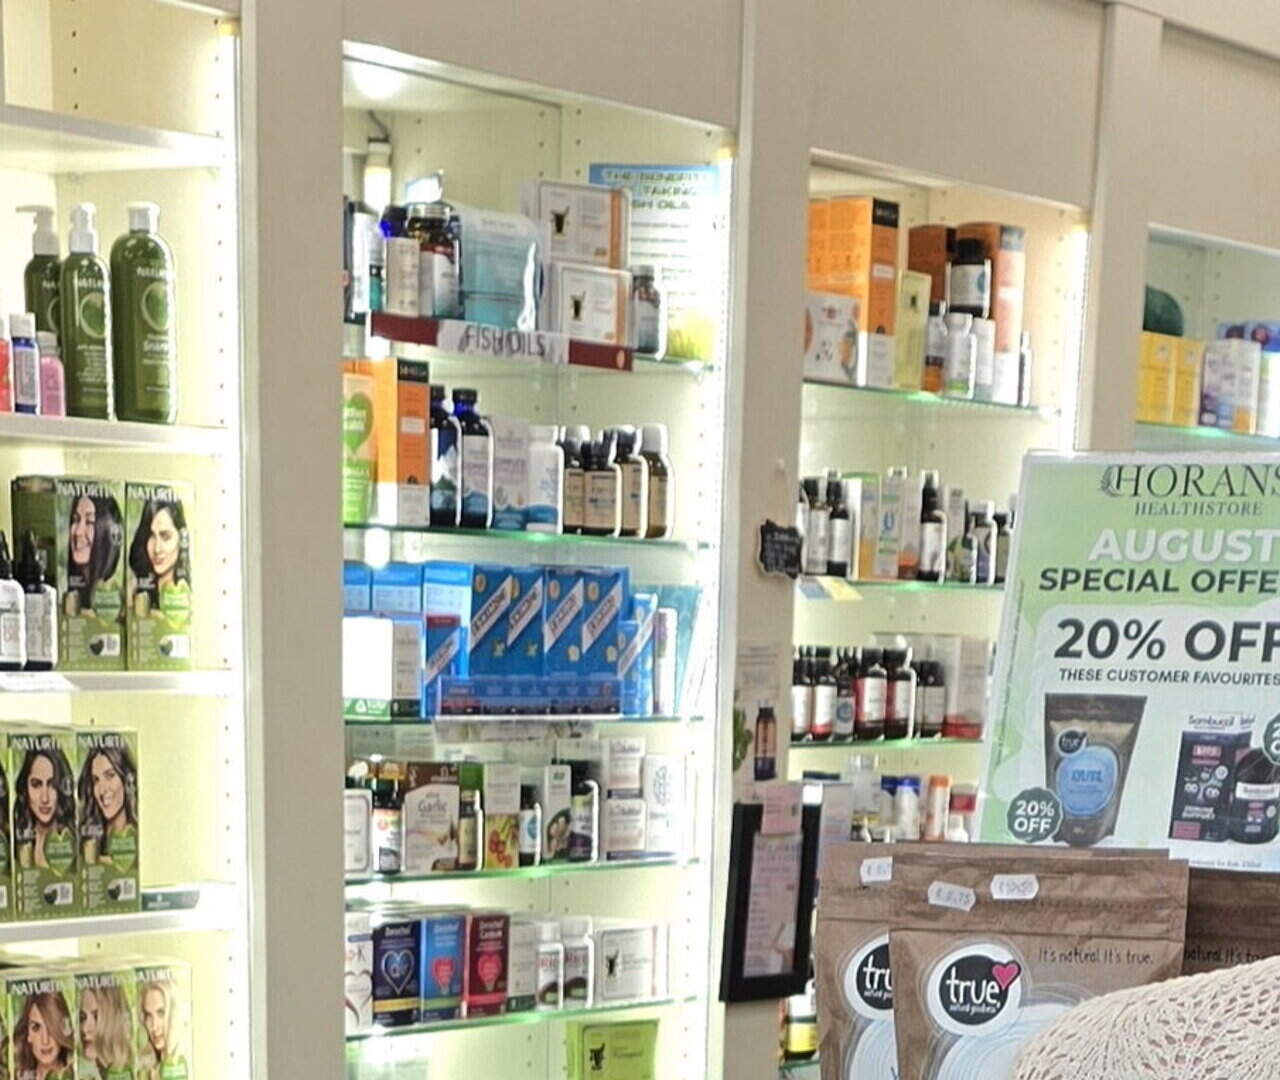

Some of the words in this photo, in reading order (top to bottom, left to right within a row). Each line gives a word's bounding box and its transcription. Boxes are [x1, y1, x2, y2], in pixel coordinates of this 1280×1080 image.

[57, 482, 116, 498] NATURTI
[1135, 501, 1264, 517] HEALTHSTORE
[1039, 567, 1180, 593] SPECIAL
[1054, 617, 1167, 662] 20%
[1059, 667, 1103, 682] THESE
[1107, 669, 1190, 684] CUSTOMER
[1015, 801, 1055, 817] 20%
[1013, 817, 1052, 833] OFF
[1038, 946, 1056, 962] It's
[1059, 947, 1100, 963] natural
[1126, 951, 1154, 965] true.
[863, 955, 893, 991] tru
[946, 966, 1000, 1005] true
